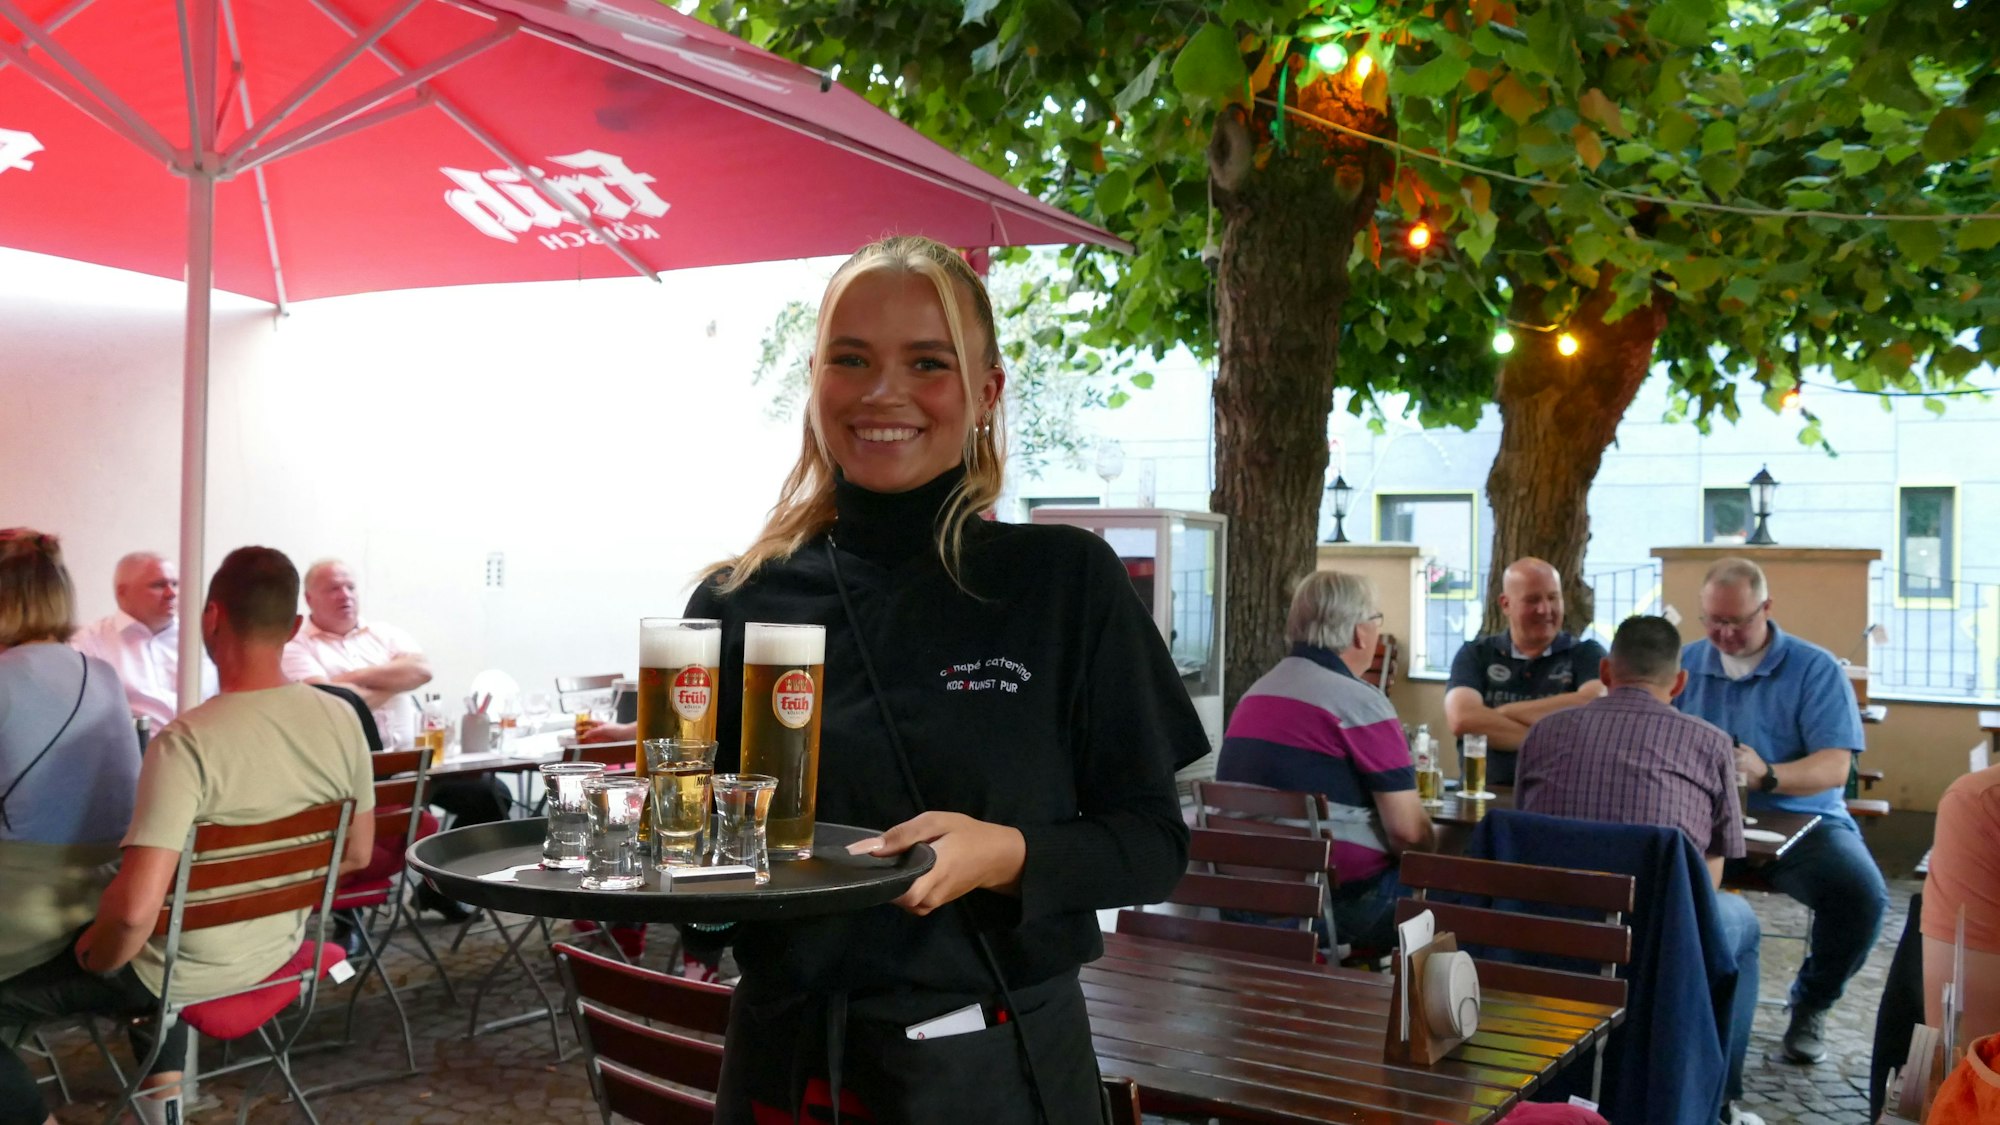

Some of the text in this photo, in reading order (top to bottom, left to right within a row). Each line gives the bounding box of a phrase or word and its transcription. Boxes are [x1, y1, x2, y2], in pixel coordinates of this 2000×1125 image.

[985, 657, 1031, 681] catering
[1000, 680, 1018, 693] PUR
[678, 690, 706, 705] früh
[781, 696, 808, 711] früh
